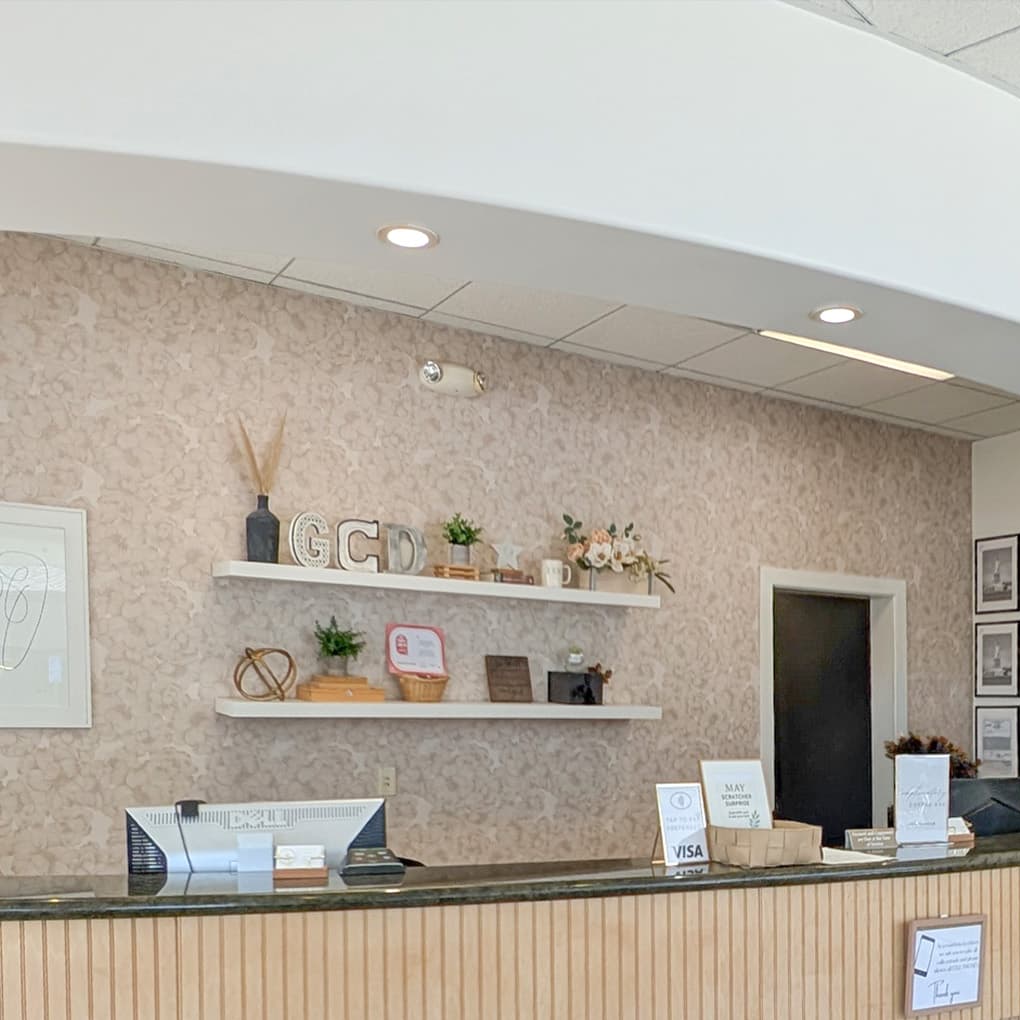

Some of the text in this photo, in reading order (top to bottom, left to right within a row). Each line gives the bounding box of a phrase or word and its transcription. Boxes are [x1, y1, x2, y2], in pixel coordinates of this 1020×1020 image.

[725, 784, 745, 792] MAY
[229, 809, 287, 827] DELL
[672, 844, 704, 858] VISA
